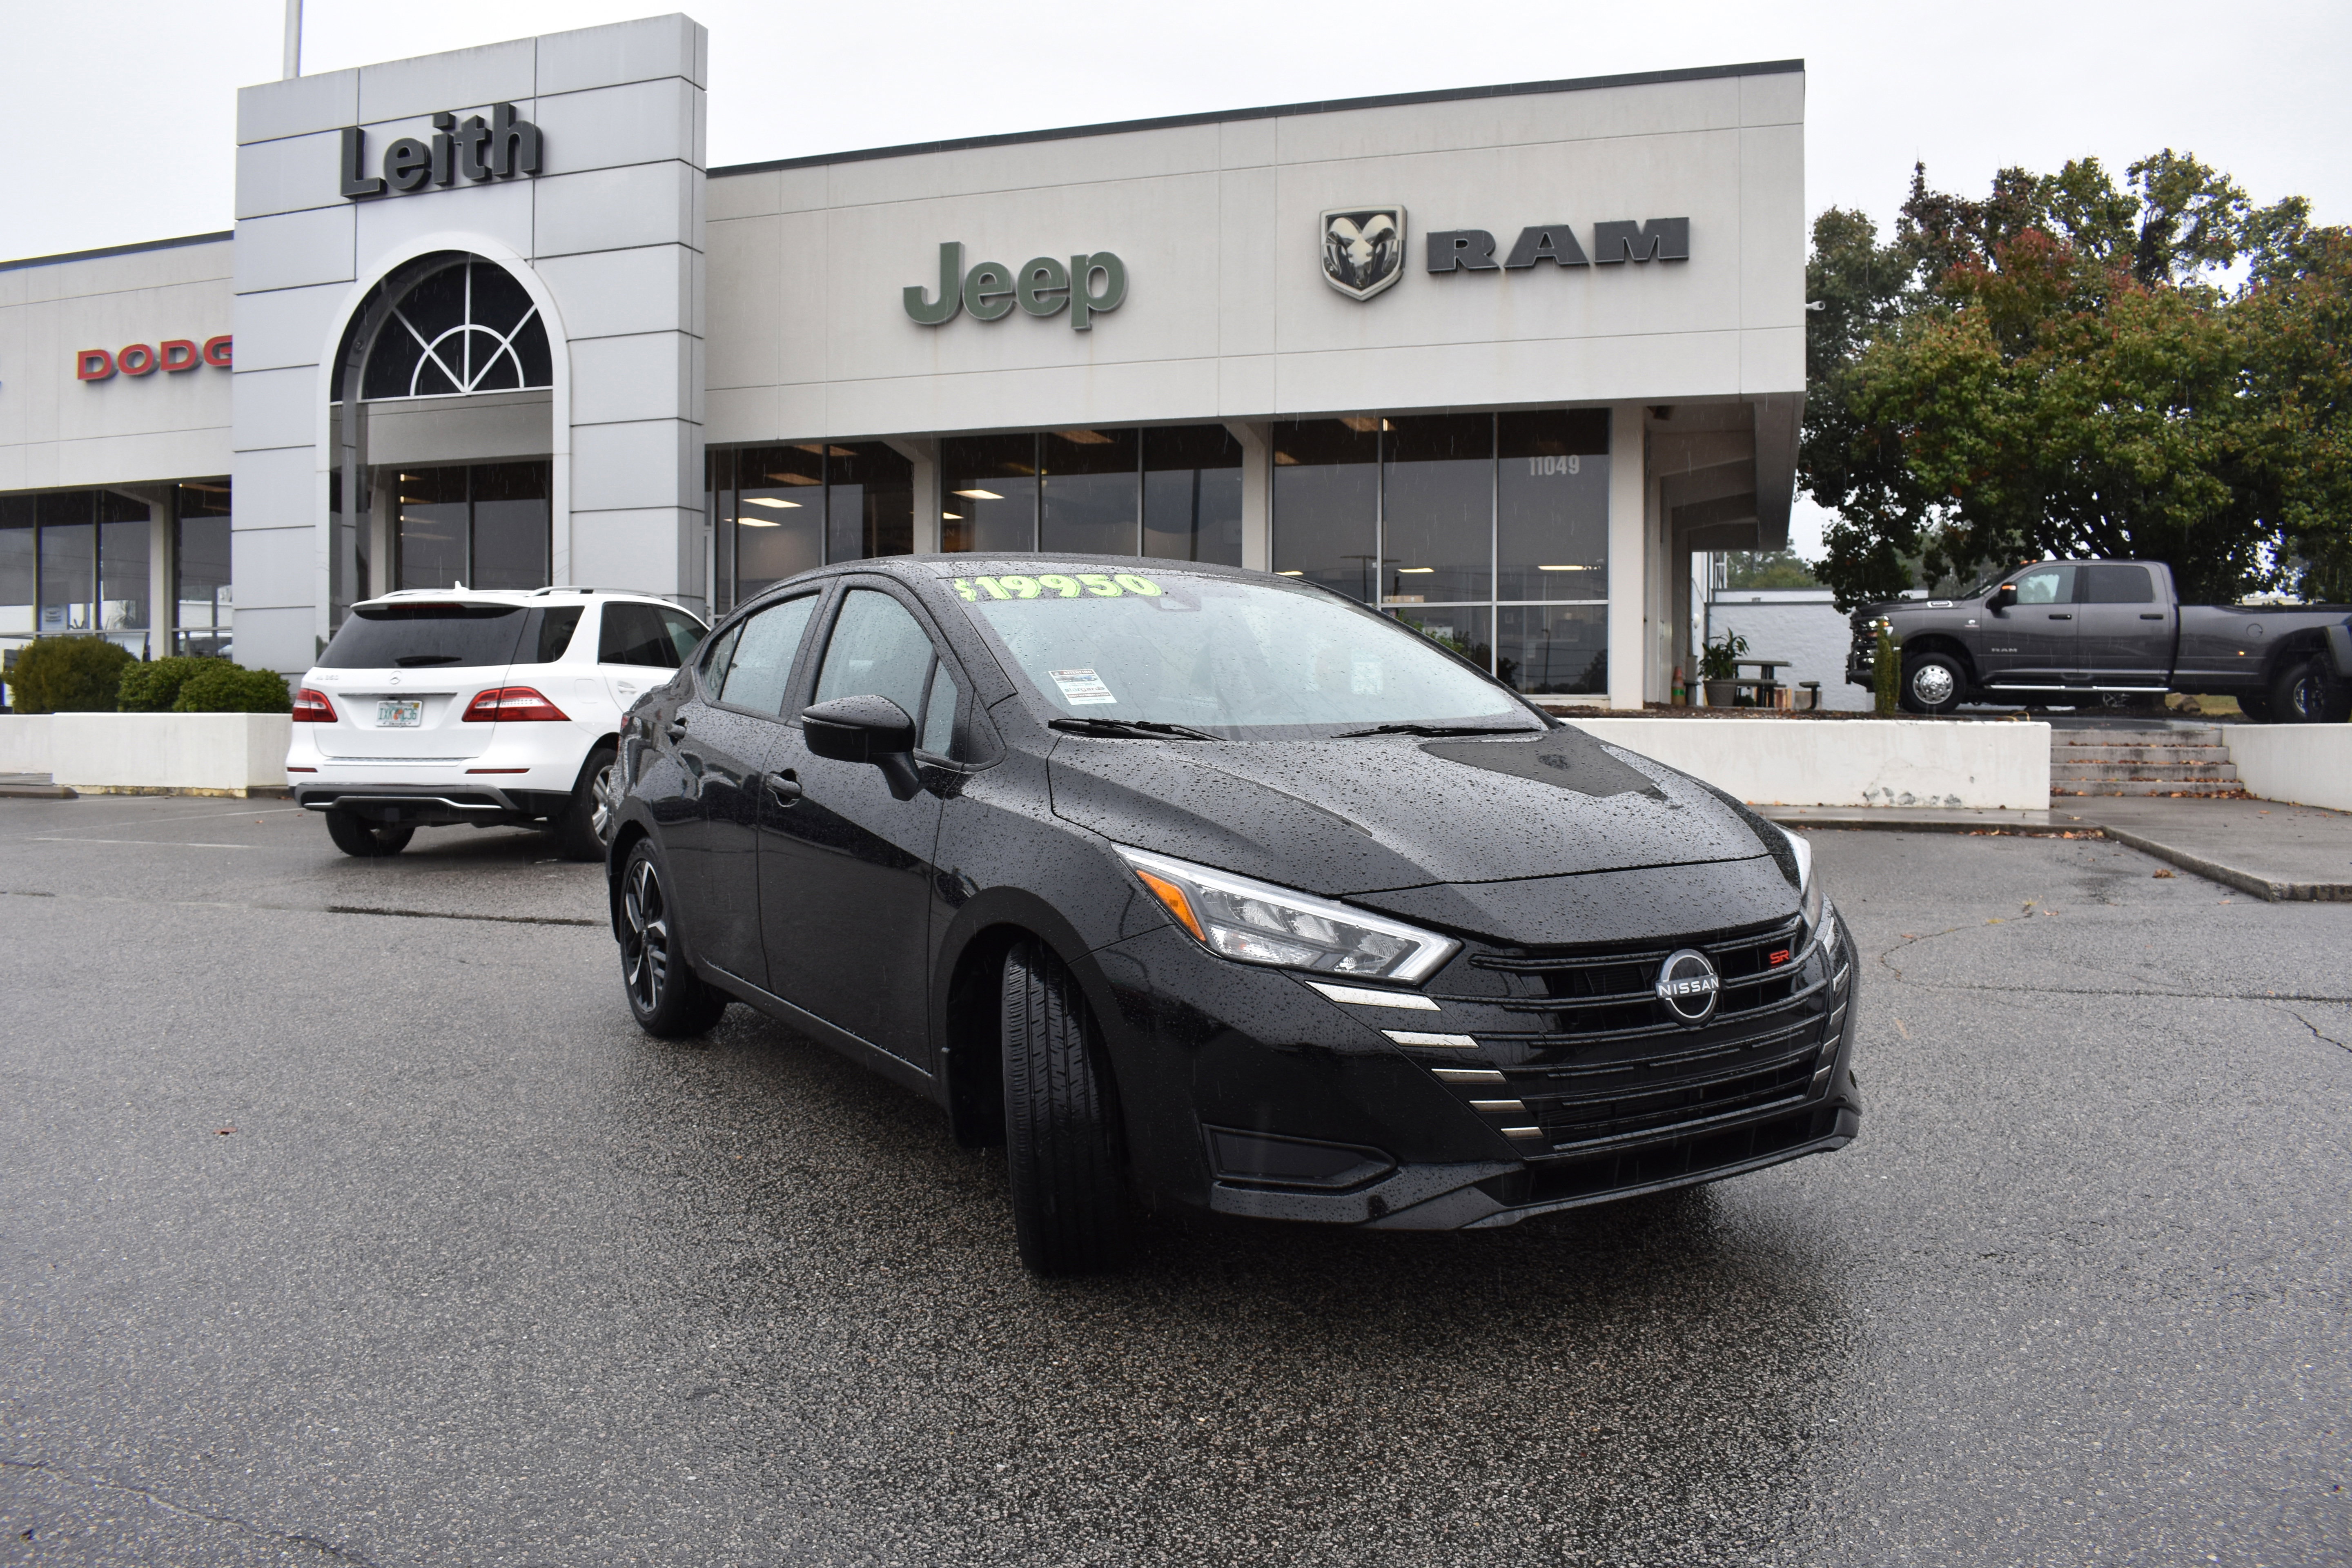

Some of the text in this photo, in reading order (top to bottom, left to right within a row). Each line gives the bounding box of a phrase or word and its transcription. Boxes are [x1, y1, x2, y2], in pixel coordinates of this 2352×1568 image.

[341, 102, 543, 199] Leith
[1427, 217, 1690, 273] RAM
[903, 241, 1129, 331] Jeep
[1529, 454, 1580, 476] 11049
[954, 574, 1162, 602] $19950
[1769, 949, 1790, 964] SR
[1658, 977, 1719, 996] NISSAN
